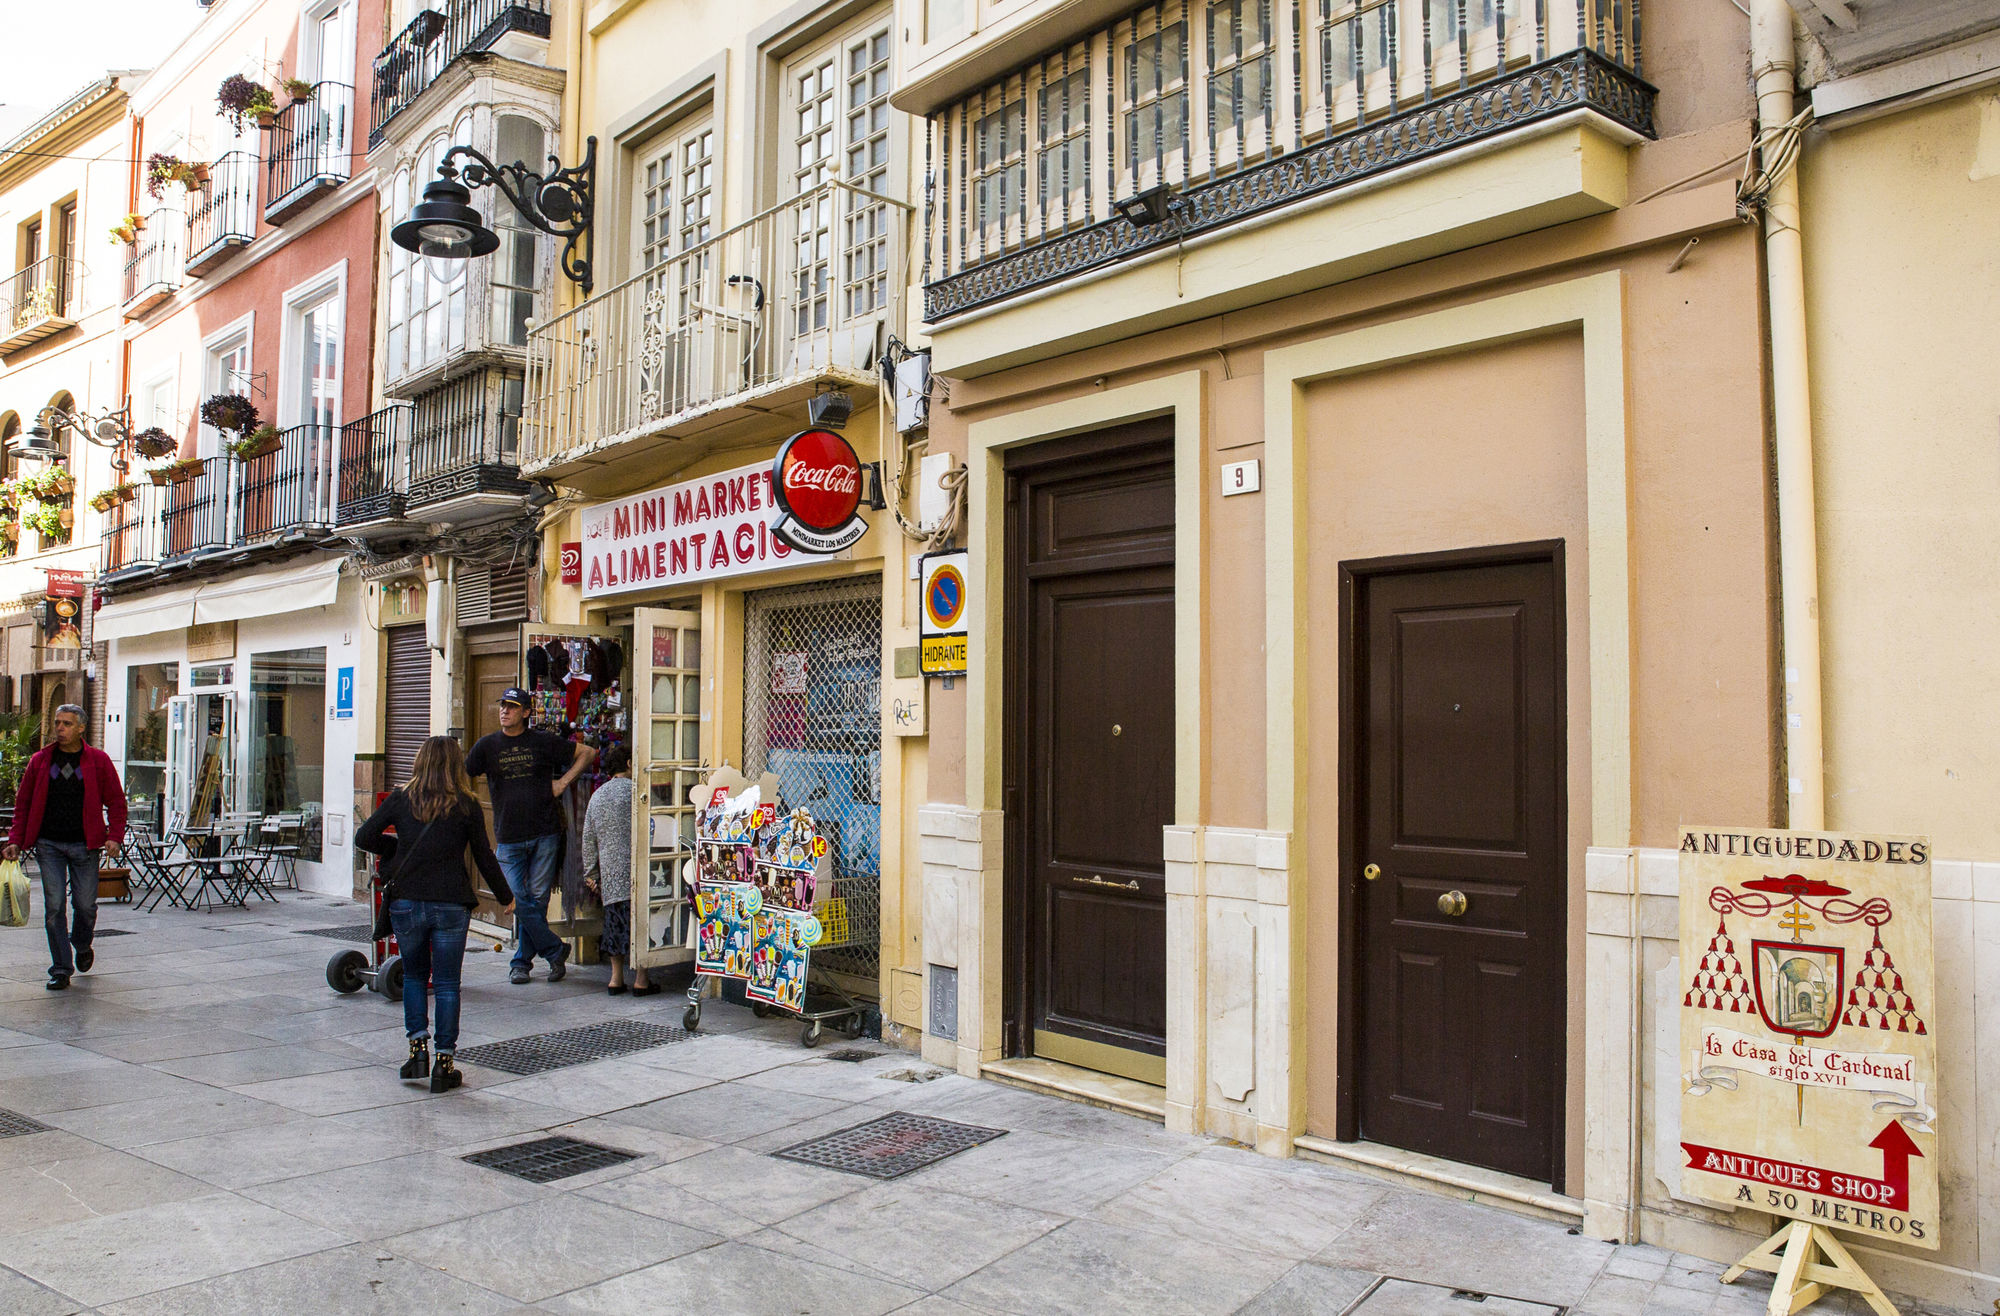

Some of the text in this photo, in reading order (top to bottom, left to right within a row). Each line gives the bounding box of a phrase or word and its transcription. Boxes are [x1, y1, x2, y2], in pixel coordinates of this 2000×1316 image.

[785, 460, 858, 494] Coca-Cola
[1235, 467, 1243, 487] 9
[613, 469, 774, 541] MINI MARKET
[791, 526, 825, 548] MINIMARKET
[825, 539, 836, 548] LOS
[924, 644, 966, 662] HIDRANTE
[340, 676, 351, 701] P
[751, 809, 764, 829] 1€
[812, 836, 825, 857] 1€
[1680, 832, 1929, 866] ANTIGÜEDADES
[1705, 1033, 1913, 1082] La Casa del Cardenal
[1768, 1065, 1847, 1086] siglo XVII
[1703, 1151, 1896, 1204] ANTIQUES SHOP
[1737, 1184, 1926, 1240] A 50 METROS
